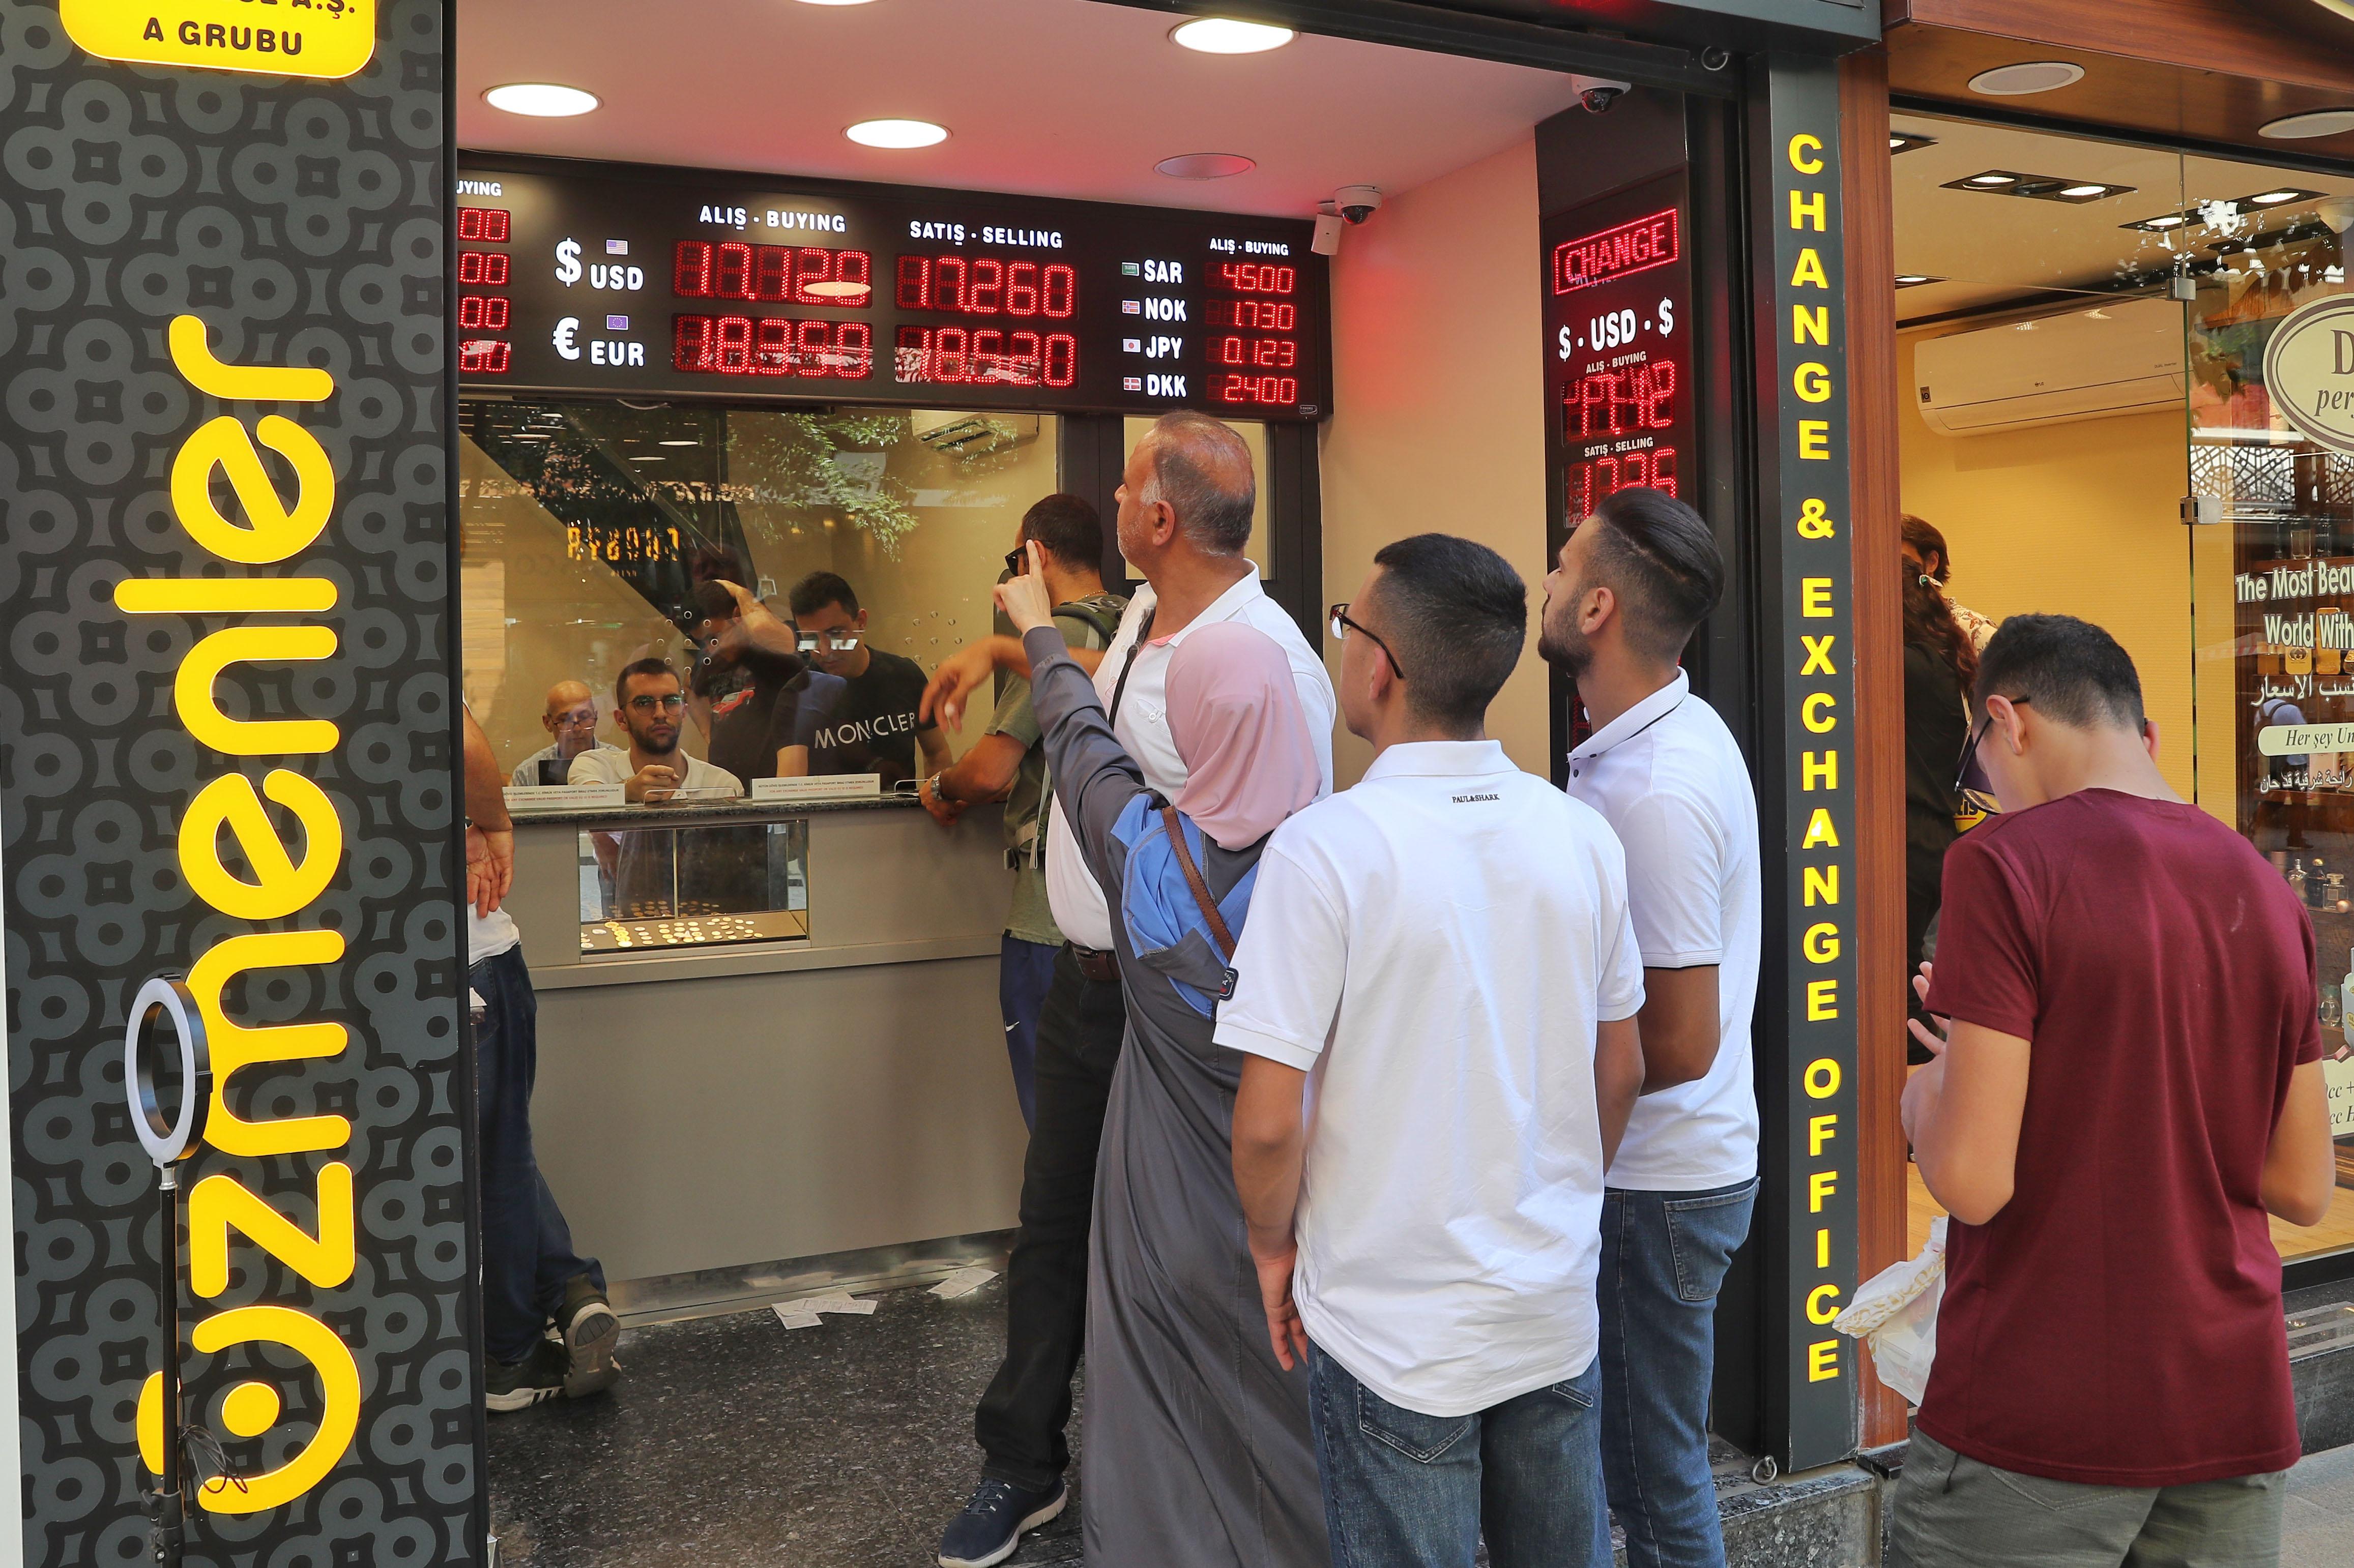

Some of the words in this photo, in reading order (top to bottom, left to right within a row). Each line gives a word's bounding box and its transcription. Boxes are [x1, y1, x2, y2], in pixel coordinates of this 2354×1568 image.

[143, 18, 164, 42] A
[178, 21, 302, 55] GRUBU
[456, 180, 502, 197] UYING
[766, 210, 846, 232] BUYING
[982, 226, 1063, 248] SELLING
[1245, 241, 1289, 256] BUYING
[1565, 221, 1665, 282] CHANGE
[590, 264, 644, 290] USD
[1144, 259, 1183, 284] SAR
[1788, 133, 1830, 460] CHANGE
[1145, 297, 1187, 322] NOK
[1590, 308, 1637, 352] USD
[590, 341, 644, 366] EUR
[1145, 336, 1182, 359] JPY
[1612, 350, 1647, 368] BUYING
[1147, 374, 1187, 398] DKK
[2313, 389, 2354, 417] per
[1615, 436, 1654, 453] SELLING
[2235, 572, 2268, 603] The
[2271, 560, 2314, 600] Most
[2263, 612, 2315, 649] World
[2285, 729, 2310, 746] Her
[1800, 577, 1840, 1021] EXCHANGE
[1803, 1058, 1841, 1383] OFFICE
